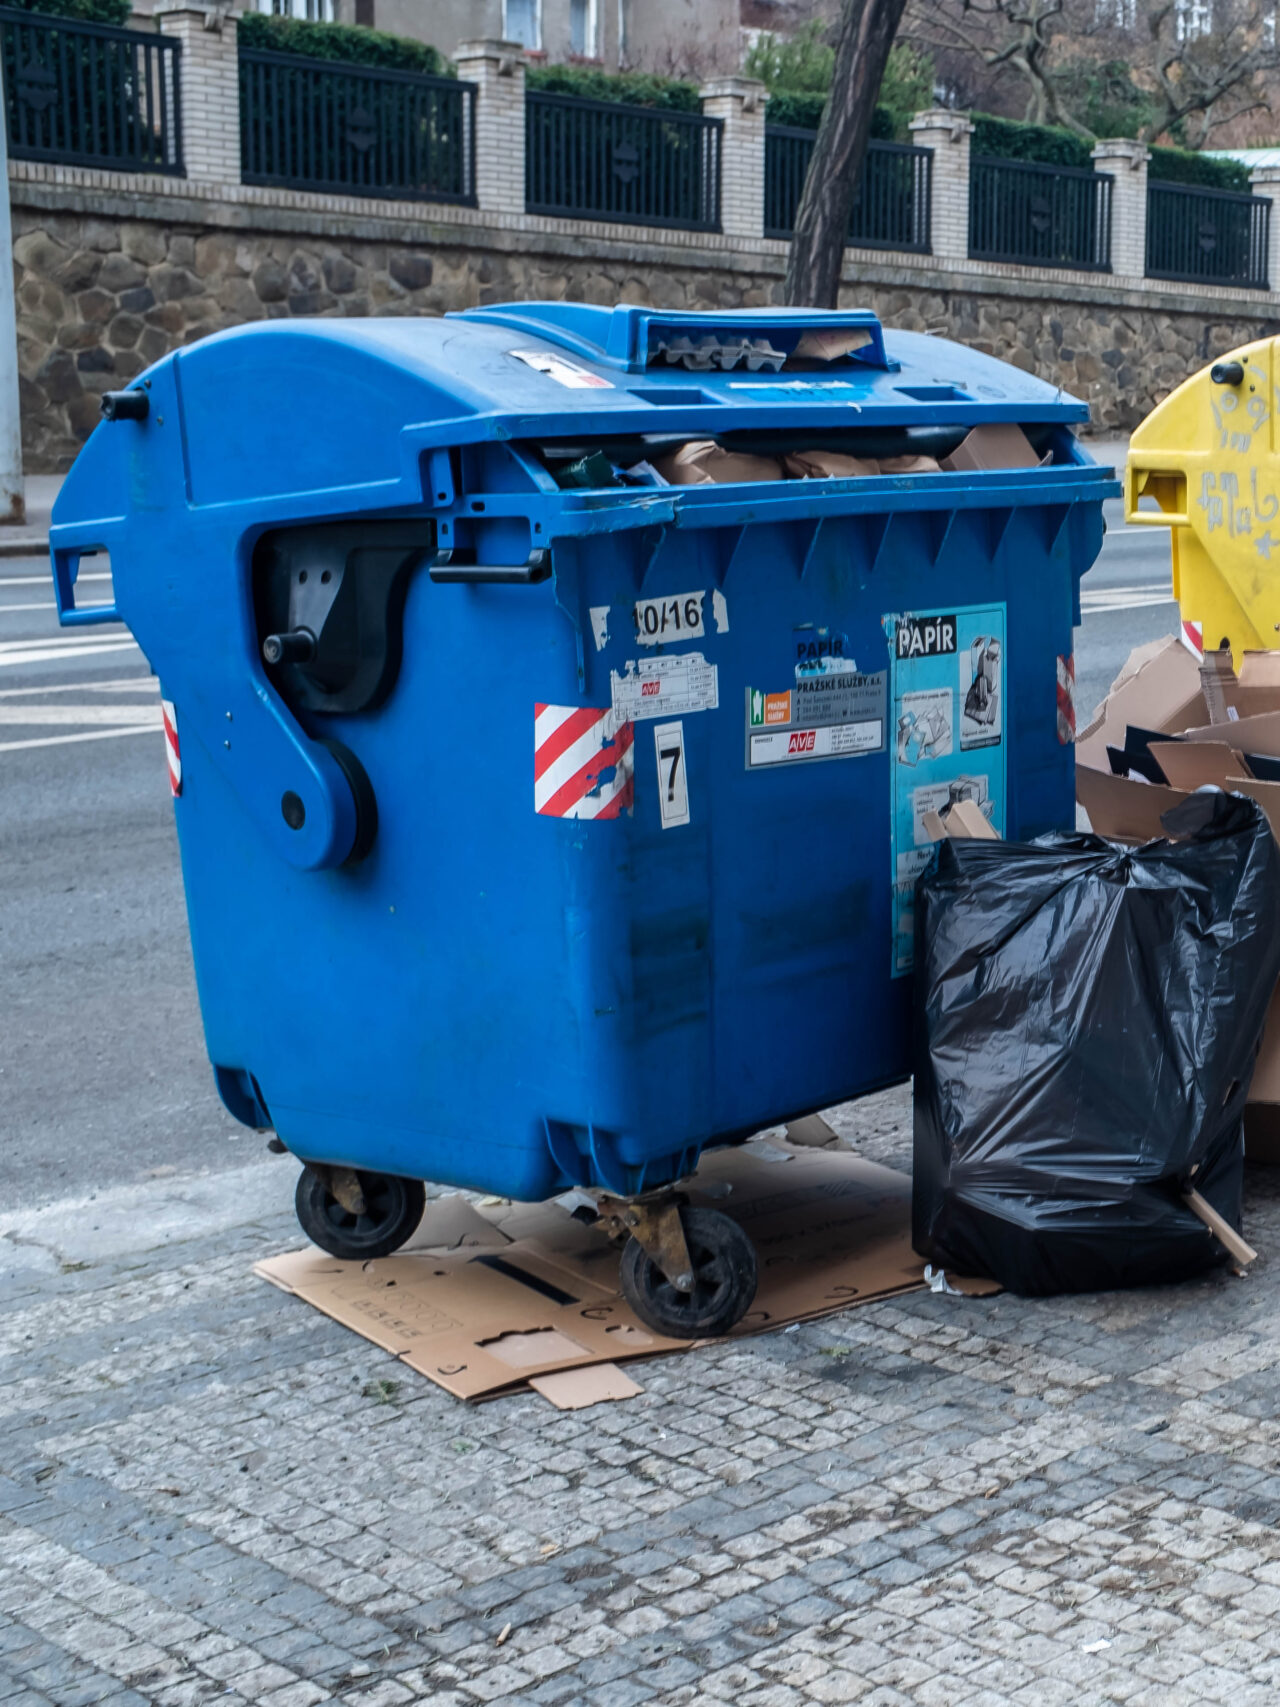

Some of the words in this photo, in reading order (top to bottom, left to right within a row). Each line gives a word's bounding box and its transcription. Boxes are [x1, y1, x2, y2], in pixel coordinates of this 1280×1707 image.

[633, 598, 703, 635] 10/16
[899, 617, 954, 656] PAPÍR
[797, 676, 835, 693] PRAŽSKÉ
[789, 732, 816, 753] AVE
[660, 747, 681, 802] 7
